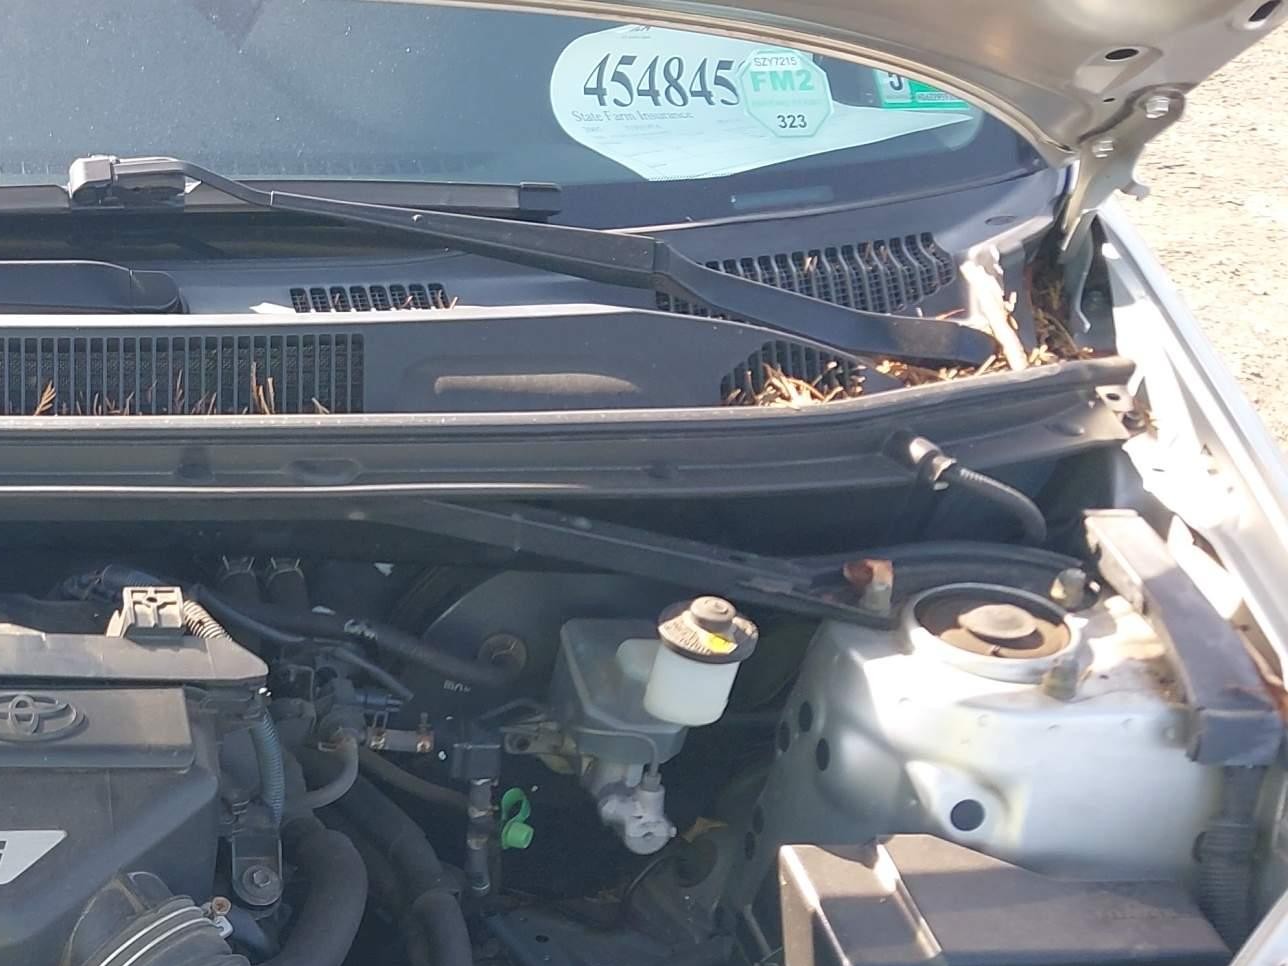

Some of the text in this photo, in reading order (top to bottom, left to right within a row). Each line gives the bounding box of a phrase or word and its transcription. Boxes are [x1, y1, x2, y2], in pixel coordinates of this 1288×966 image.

[753, 56, 798, 67] SZY7215
[583, 53, 745, 107] 454845
[749, 69, 815, 92] FM2
[572, 110, 603, 122] State
[604, 111, 637, 121] Farm
[776, 114, 808, 129] 323
